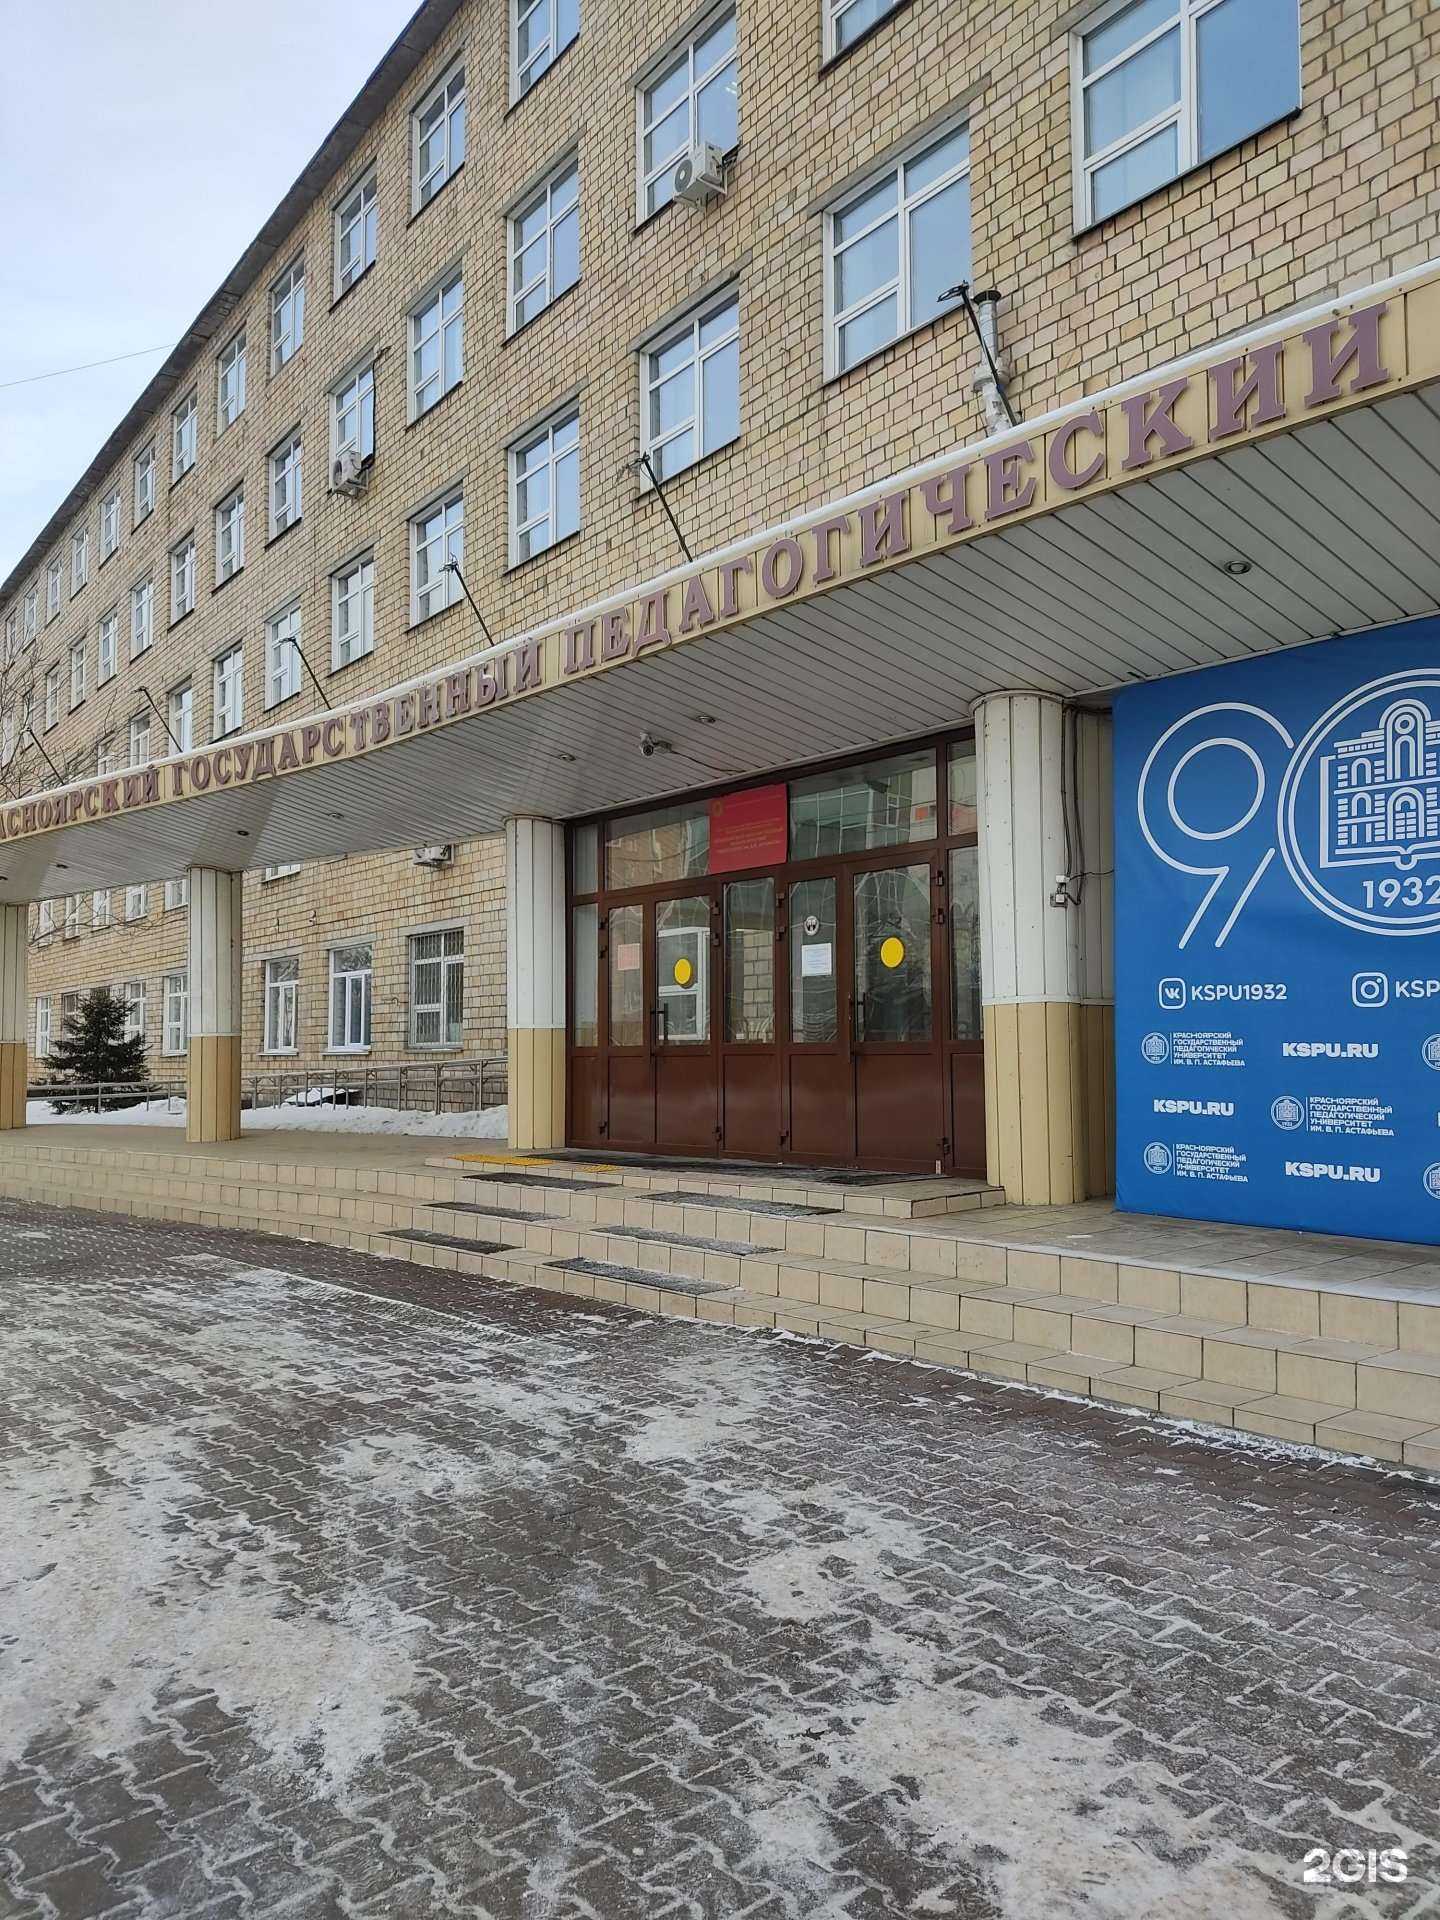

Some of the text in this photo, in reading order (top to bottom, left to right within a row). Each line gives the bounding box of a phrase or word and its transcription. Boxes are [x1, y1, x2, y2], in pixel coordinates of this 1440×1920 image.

[172, 637, 542, 796] ГОСУДАРСТВЕННЫЙ
[1362, 874, 1440, 909] 1932
[1191, 983, 1288, 1001] KSPU1932
[1282, 1042, 1379, 1058] KSPU.RU
[1153, 1099, 1234, 1116] KSPU.RU
[1309, 1096, 1379, 1106] КРАСНОЯРСКИЙ
[1309, 1104, 1393, 1114] ГОСУДАРСТВЕННЫЙ
[1309, 1111, 1385, 1121] ПЕДАГОГИЧЕСКИЙ
[1310, 1118, 1373, 1128] УНИВЕРСИТЕТ
[1345, 1127, 1395, 1137] АСТАФЬЕВА
[1285, 1161, 1380, 1183] KSPU.RU
